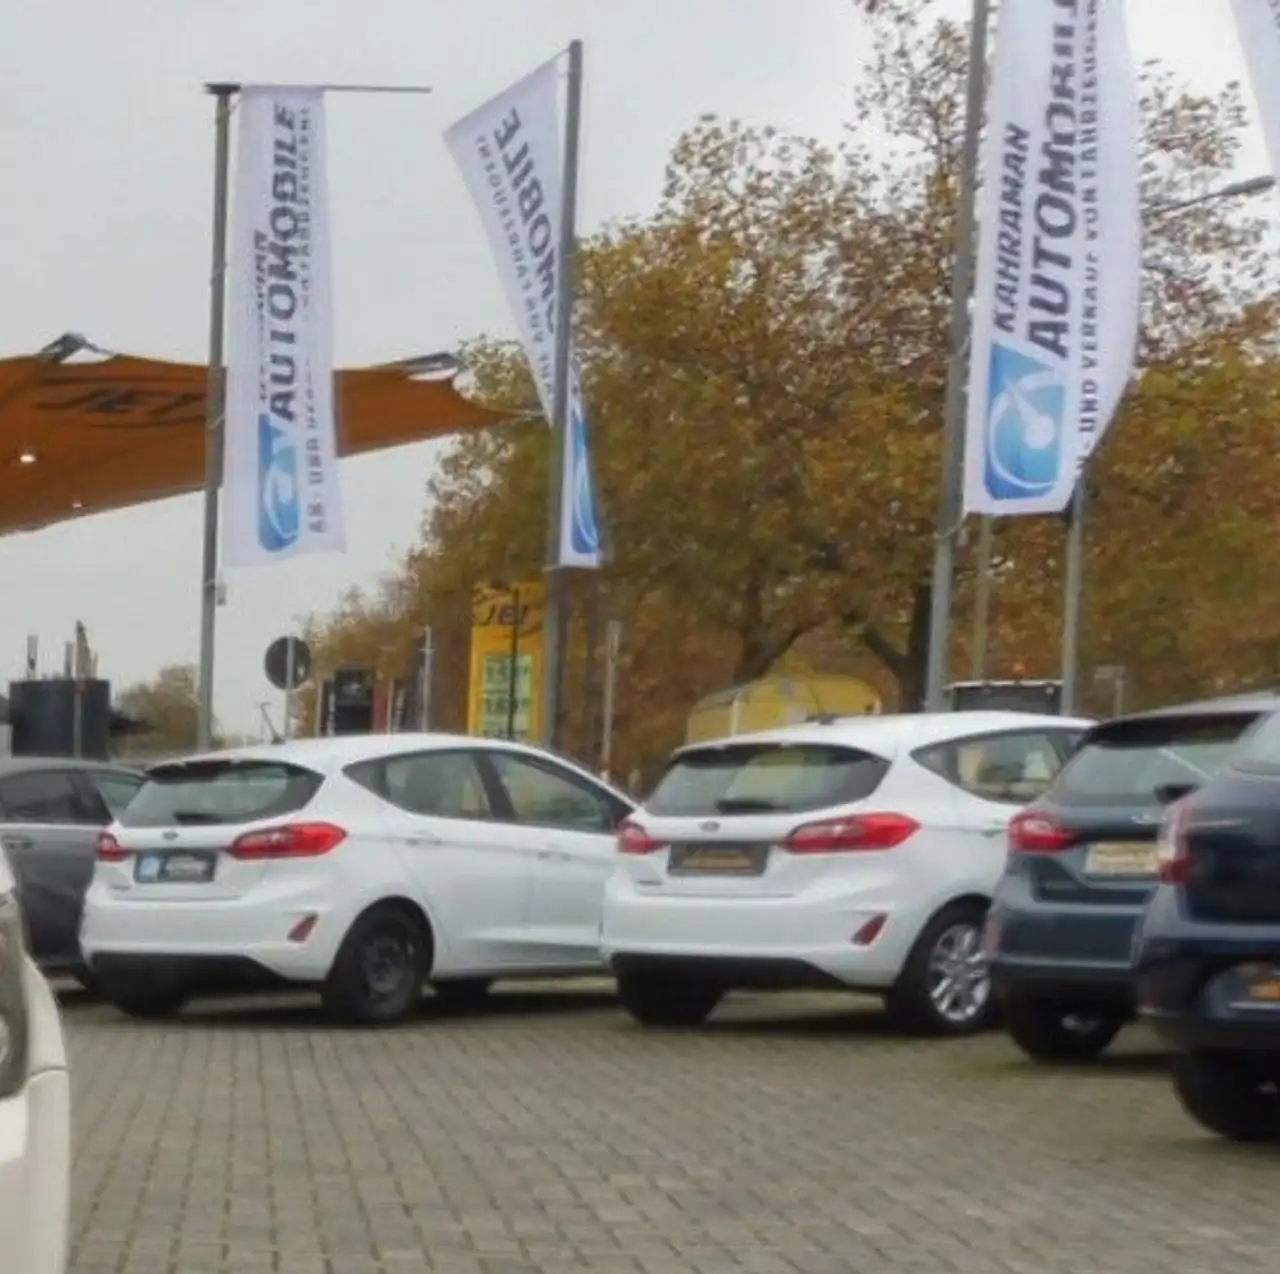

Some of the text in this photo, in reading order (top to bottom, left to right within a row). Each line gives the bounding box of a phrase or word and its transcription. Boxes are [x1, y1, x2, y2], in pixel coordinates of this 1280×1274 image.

[266, 103, 299, 423] AUTOMOBILE
[995, 123, 1030, 333] KAHRAMAN
[1027, 0, 1078, 360] AUTOMOBIL
